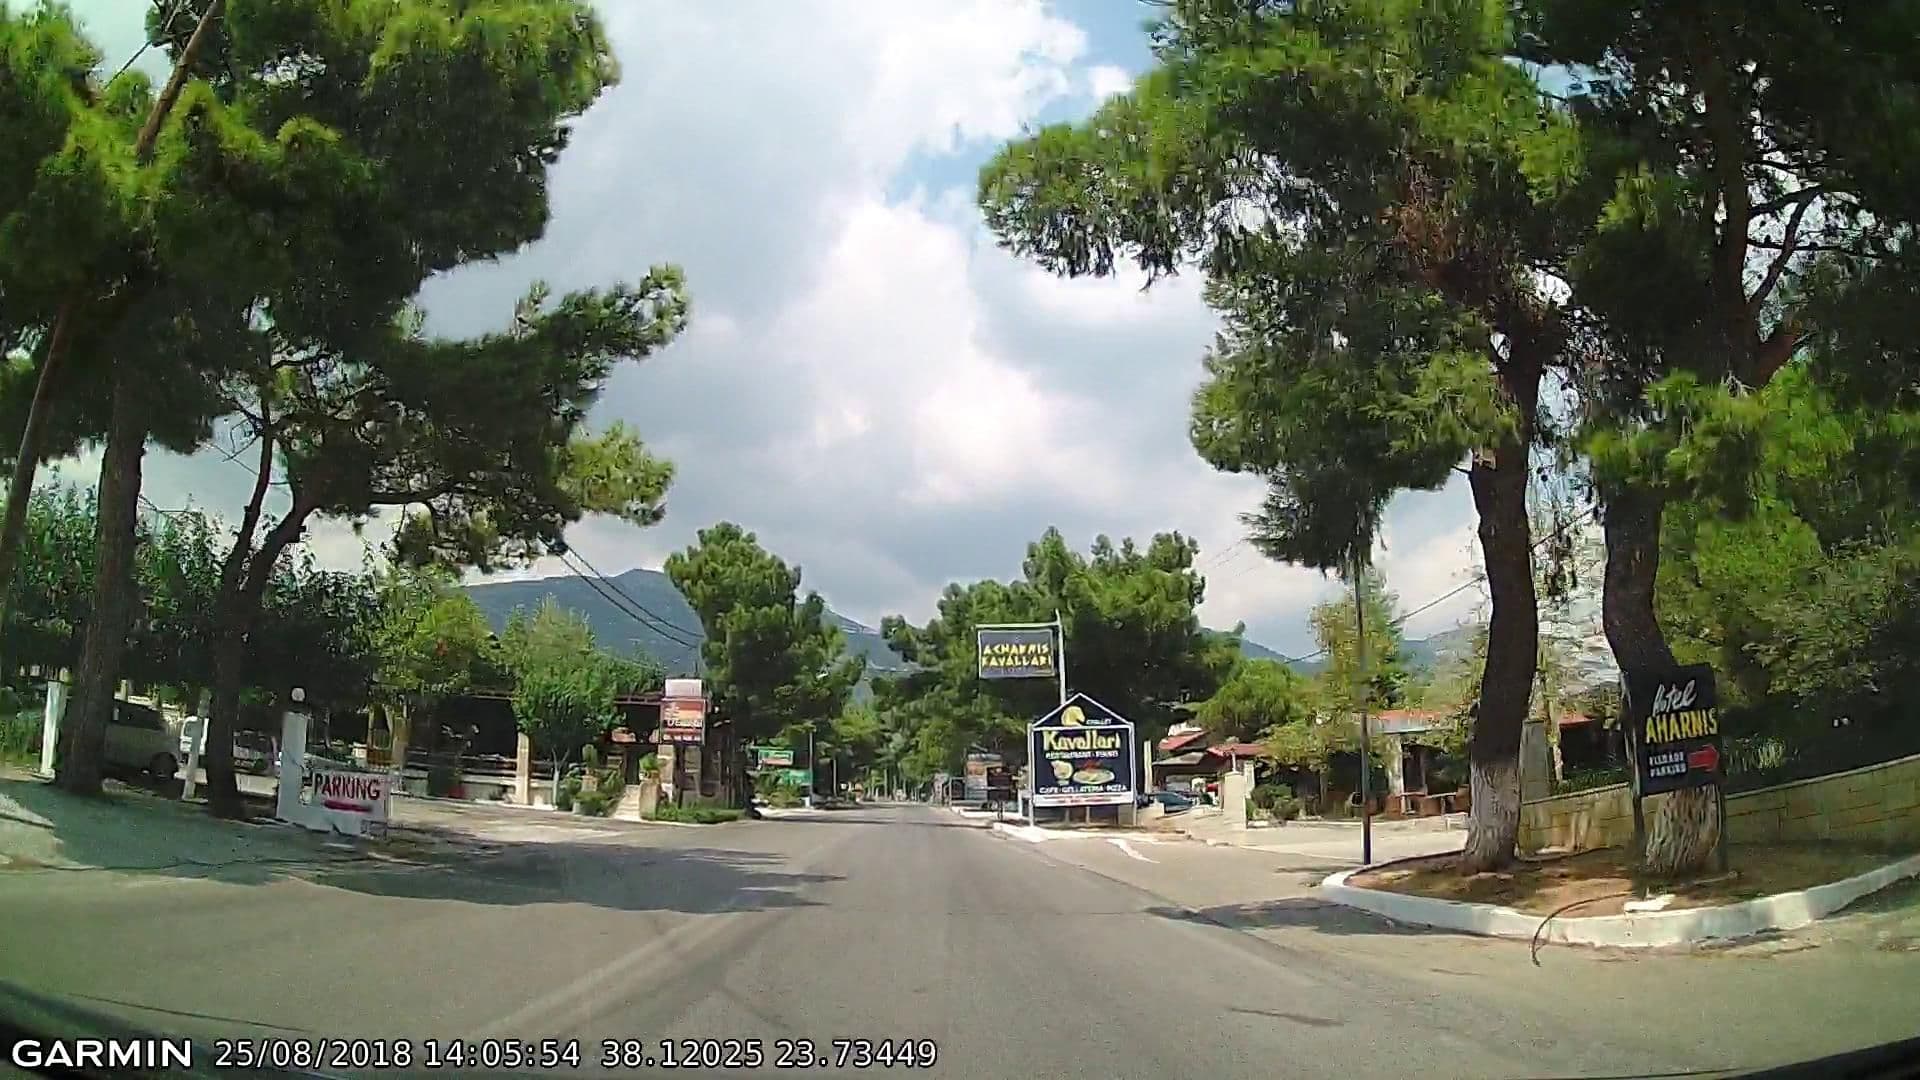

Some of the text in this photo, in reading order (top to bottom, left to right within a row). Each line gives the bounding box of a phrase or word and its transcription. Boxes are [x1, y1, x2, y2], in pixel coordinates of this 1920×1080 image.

[982, 655, 1052, 667] KAVALLARI
[1646, 708, 1718, 744] AHARNIS
[1043, 730, 1120, 750] Kavallari
[313, 772, 380, 800] PARKING
